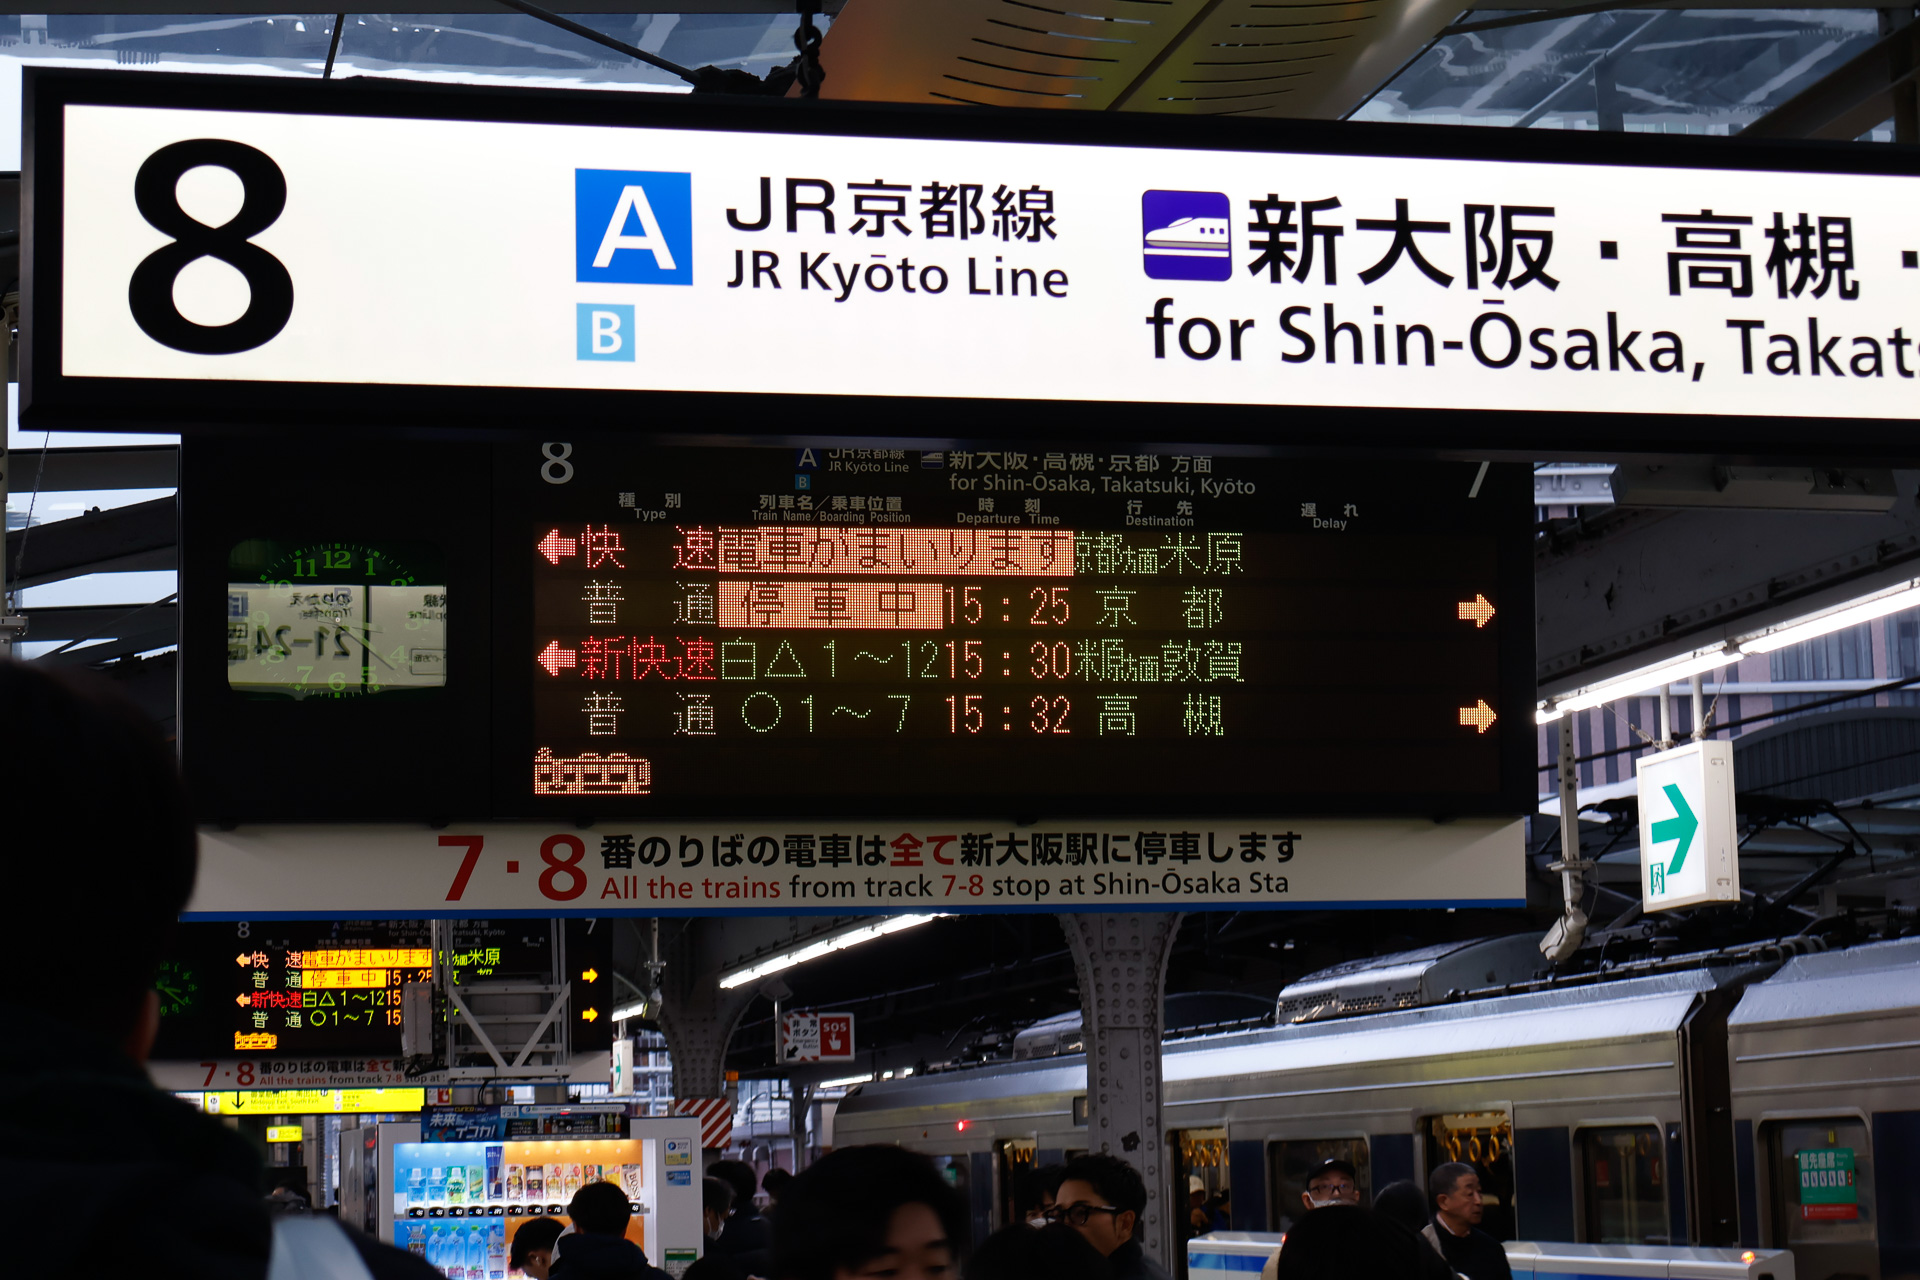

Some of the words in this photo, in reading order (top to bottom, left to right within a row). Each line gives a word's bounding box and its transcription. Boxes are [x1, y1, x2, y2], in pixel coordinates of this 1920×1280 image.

[725, 176, 1058, 244] JR京都線
[591, 185, 677, 270] A
[128, 137, 295, 356] 8
[726, 249, 783, 290] JR
[799, 250, 950, 303] Kyōto
[967, 255, 1069, 298] Line
[591, 310, 624, 355] B
[1145, 297, 1256, 361] for
[1278, 299, 1707, 382] Shin-Ōsaka,
[1726, 316, 1920, 379] Takat
[540, 442, 574, 485] 8
[798, 448, 818, 468] A
[828, 461, 843, 472] JR
[845, 461, 882, 475] Kyōto
[884, 462, 910, 473] Line
[1171, 454, 1213, 475] 方面
[799, 476, 808, 489] B
[949, 474, 979, 491] for
[983, 471, 1096, 494] Shin-Ōsaka,
[1101, 475, 1196, 497] Takatsuki,
[1201, 477, 1256, 498] Kyōto
[634, 508, 667, 521] Type
[752, 509, 780, 522] Train
[869, 511, 911, 523] Position
[956, 513, 1021, 527] Departure
[1029, 513, 1060, 525] Time
[1126, 515, 1194, 528] Destination
[1312, 518, 1348, 531] Delay
[322, 550, 352, 569] 12
[719, 527, 1070, 574] 電車がまいります
[293, 558, 319, 577] 11
[364, 557, 377, 576] 1
[740, 583, 918, 627] 停車中
[945, 586, 1070, 626] 15:25
[581, 636, 717, 681] 新快速
[945, 640, 1070, 680] 15:30
[296, 665, 315, 685] 7
[327, 672, 347, 692] 6
[945, 694, 1071, 734] 15:32
[600, 831, 1303, 869] 番のりばの電車は全て新大阪駅に停車します
[600, 876, 638, 900] All
[646, 876, 694, 900] the
[701, 876, 781, 899] trains
[788, 875, 856, 898] from
[864, 873, 934, 897] track
[941, 874, 985, 897] 7-8
[992, 876, 1051, 901] stop
[1058, 877, 1086, 896] at
[1093, 867, 1241, 895] Shin-Ōsaka
[1249, 871, 1290, 894] Sta
[237, 921, 251, 939] 8
[585, 918, 598, 935] 7
[251, 990, 302, 1008] 新快速
[792, 1029, 818, 1037] ボタン
[822, 1021, 848, 1034] SOS
[259, 1076, 274, 1086] All
[276, 1075, 294, 1085] the
[297, 1075, 327, 1085] trains
[329, 1075, 354, 1084] from
[357, 1073, 383, 1083] track
[386, 1074, 402, 1083] 7-8
